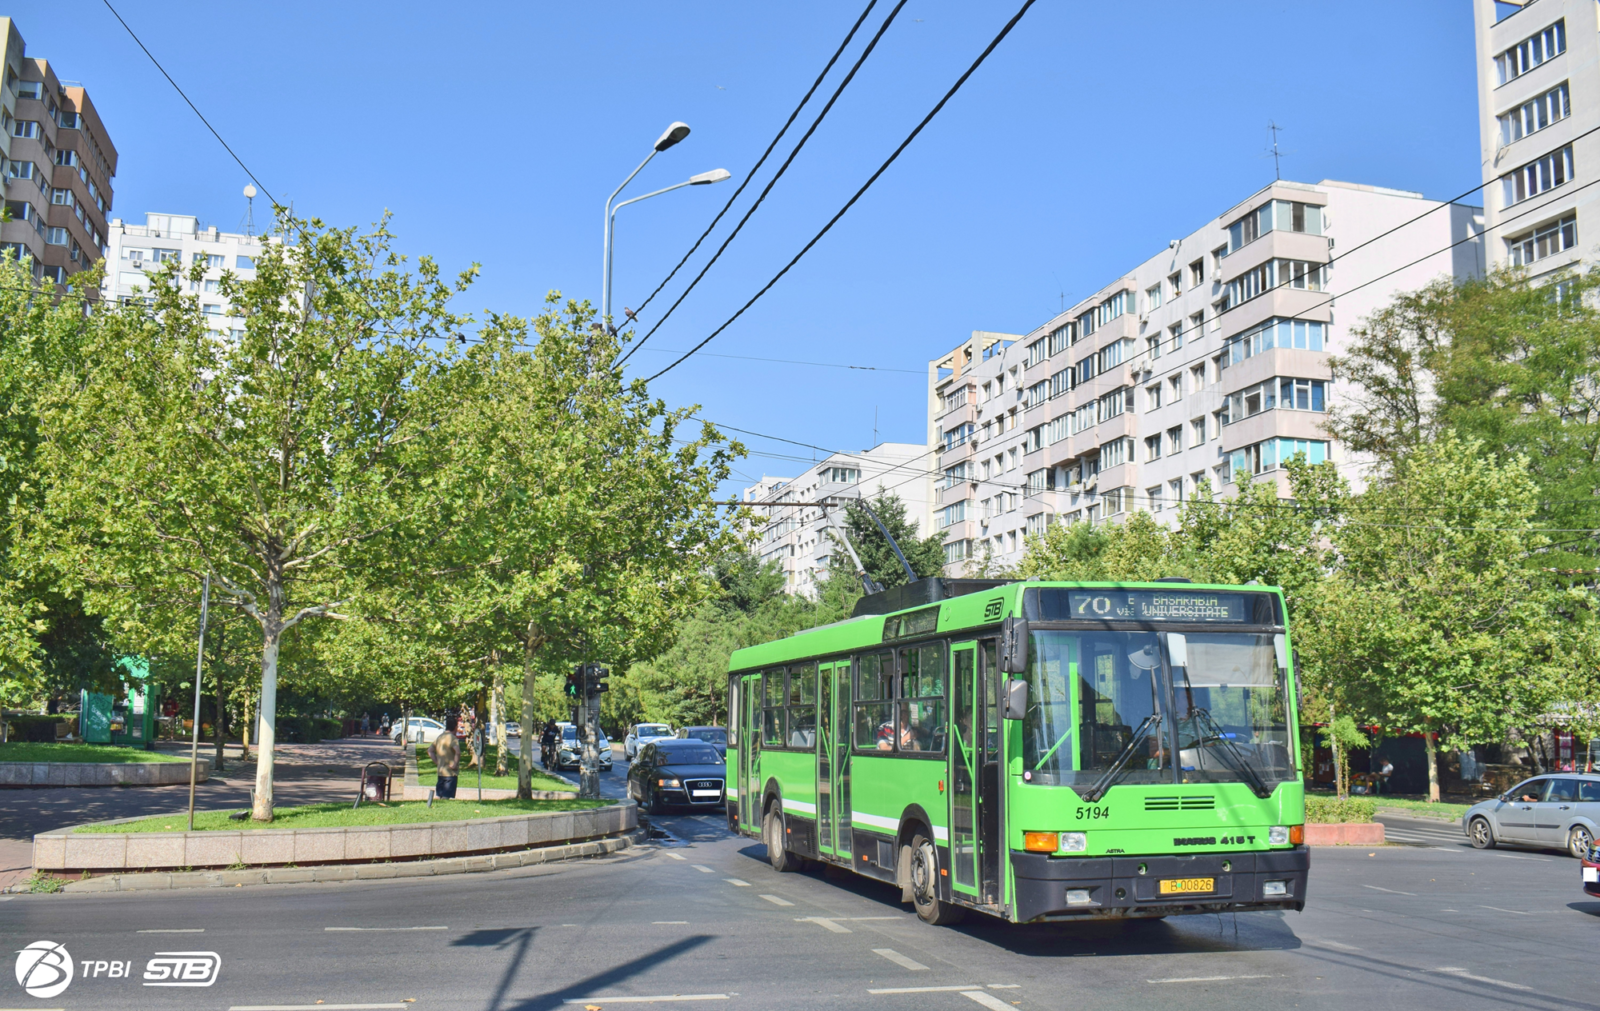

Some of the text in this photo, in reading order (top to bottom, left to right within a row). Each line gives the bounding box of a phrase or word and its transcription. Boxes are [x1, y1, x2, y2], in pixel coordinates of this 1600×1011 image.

[1074, 596, 1111, 614] 70
[1153, 594, 1218, 606] BASARABIA
[984, 601, 1002, 618] STB
[1075, 806, 1109, 820] 5194
[1220, 835, 1245, 845] 415
[1247, 835, 1255, 844] T
